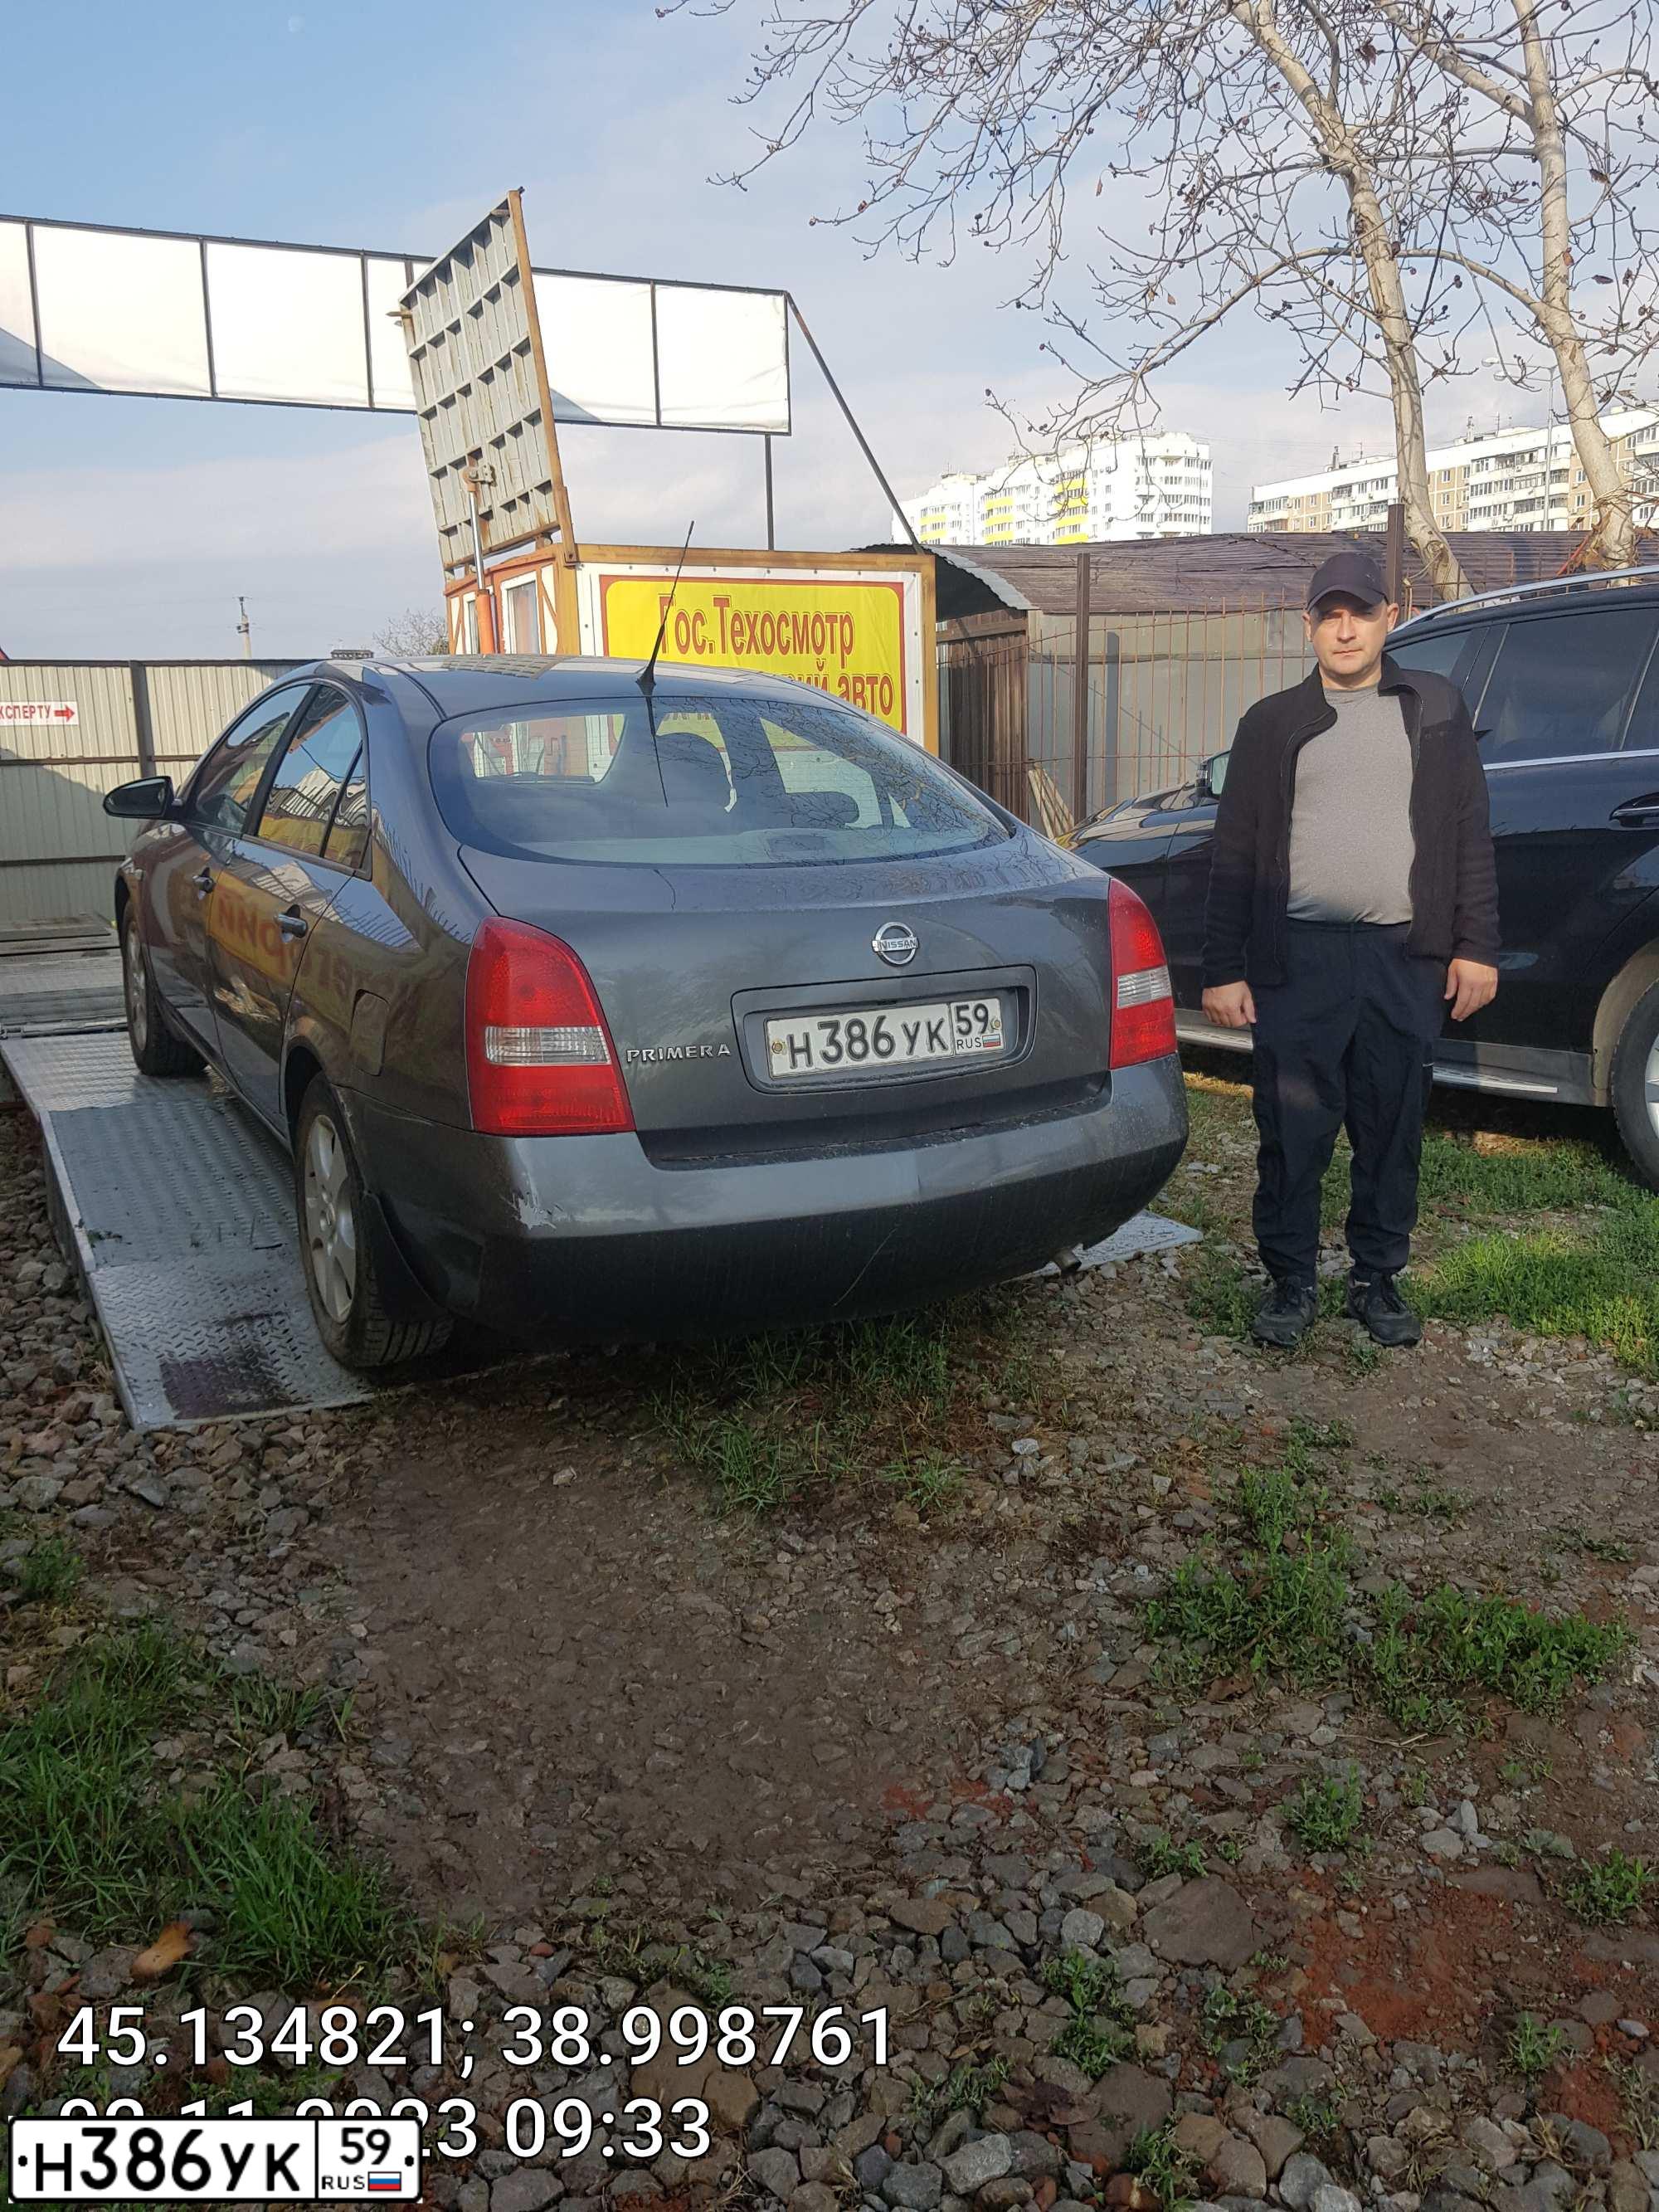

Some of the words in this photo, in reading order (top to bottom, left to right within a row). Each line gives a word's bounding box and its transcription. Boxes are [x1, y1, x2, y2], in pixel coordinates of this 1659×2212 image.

[879, 939, 916, 951] NISSAN
[954, 1002, 989, 1035] 59
[956, 1037, 981, 1050] RUS
[626, 1044, 731, 1063] PRIMERA
